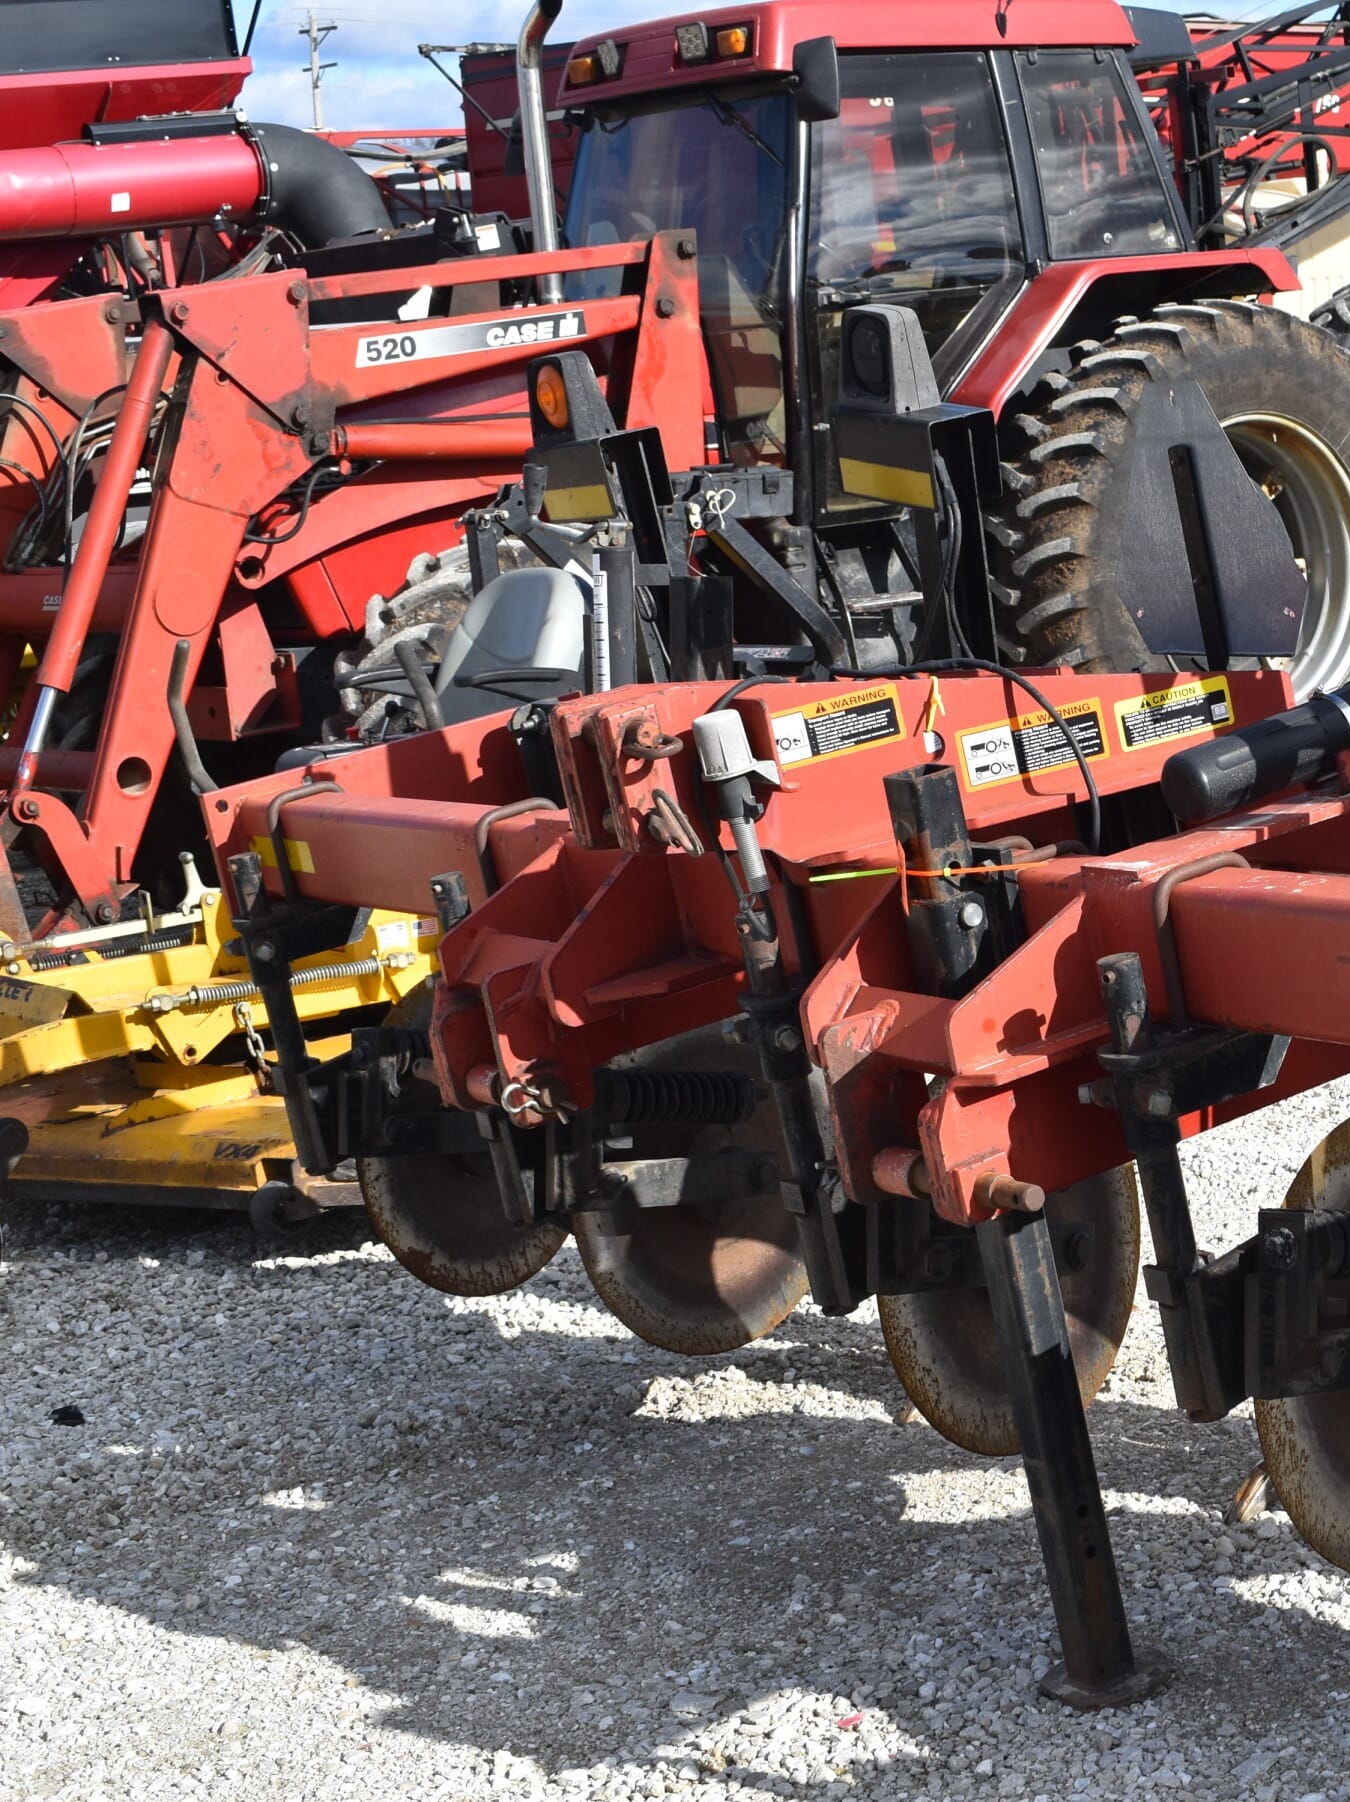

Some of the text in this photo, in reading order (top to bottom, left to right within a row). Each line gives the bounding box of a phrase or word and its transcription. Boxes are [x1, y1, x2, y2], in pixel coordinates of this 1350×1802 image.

[366, 335, 417, 362] 520
[486, 320, 554, 348] CASE
[830, 689, 887, 710] WARNING
[1152, 686, 1196, 705] CAUTION
